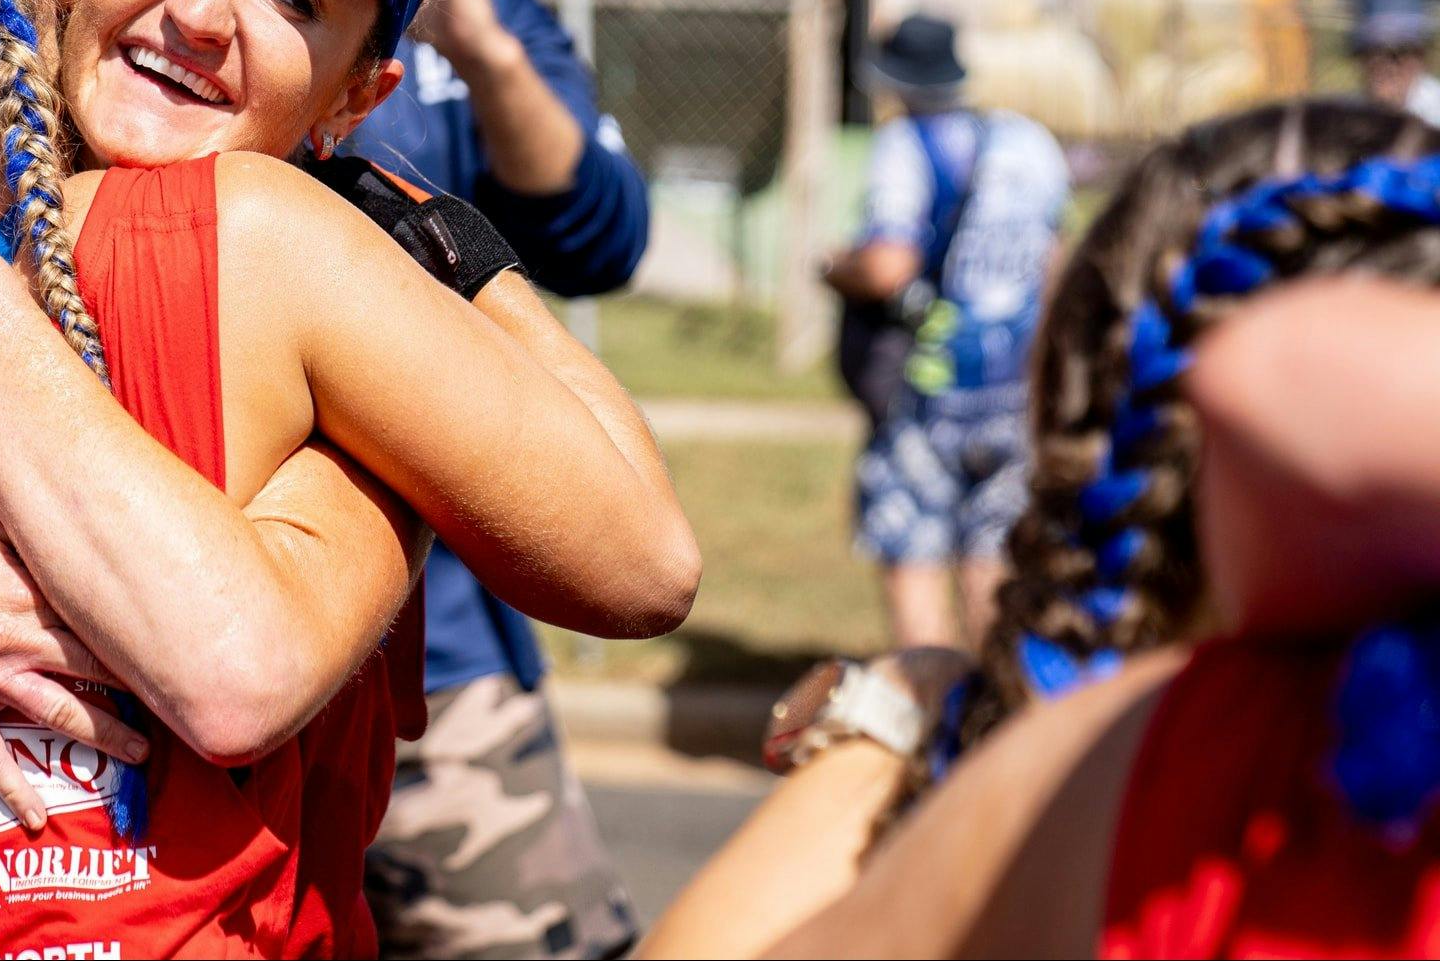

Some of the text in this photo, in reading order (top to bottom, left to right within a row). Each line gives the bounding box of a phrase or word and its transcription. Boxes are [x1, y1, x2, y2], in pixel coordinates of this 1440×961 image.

[14, 875, 127, 889] INDUSTRIAL EQUIPMENT
[32, 892, 55, 903] your
[55, 890, 96, 902] business
